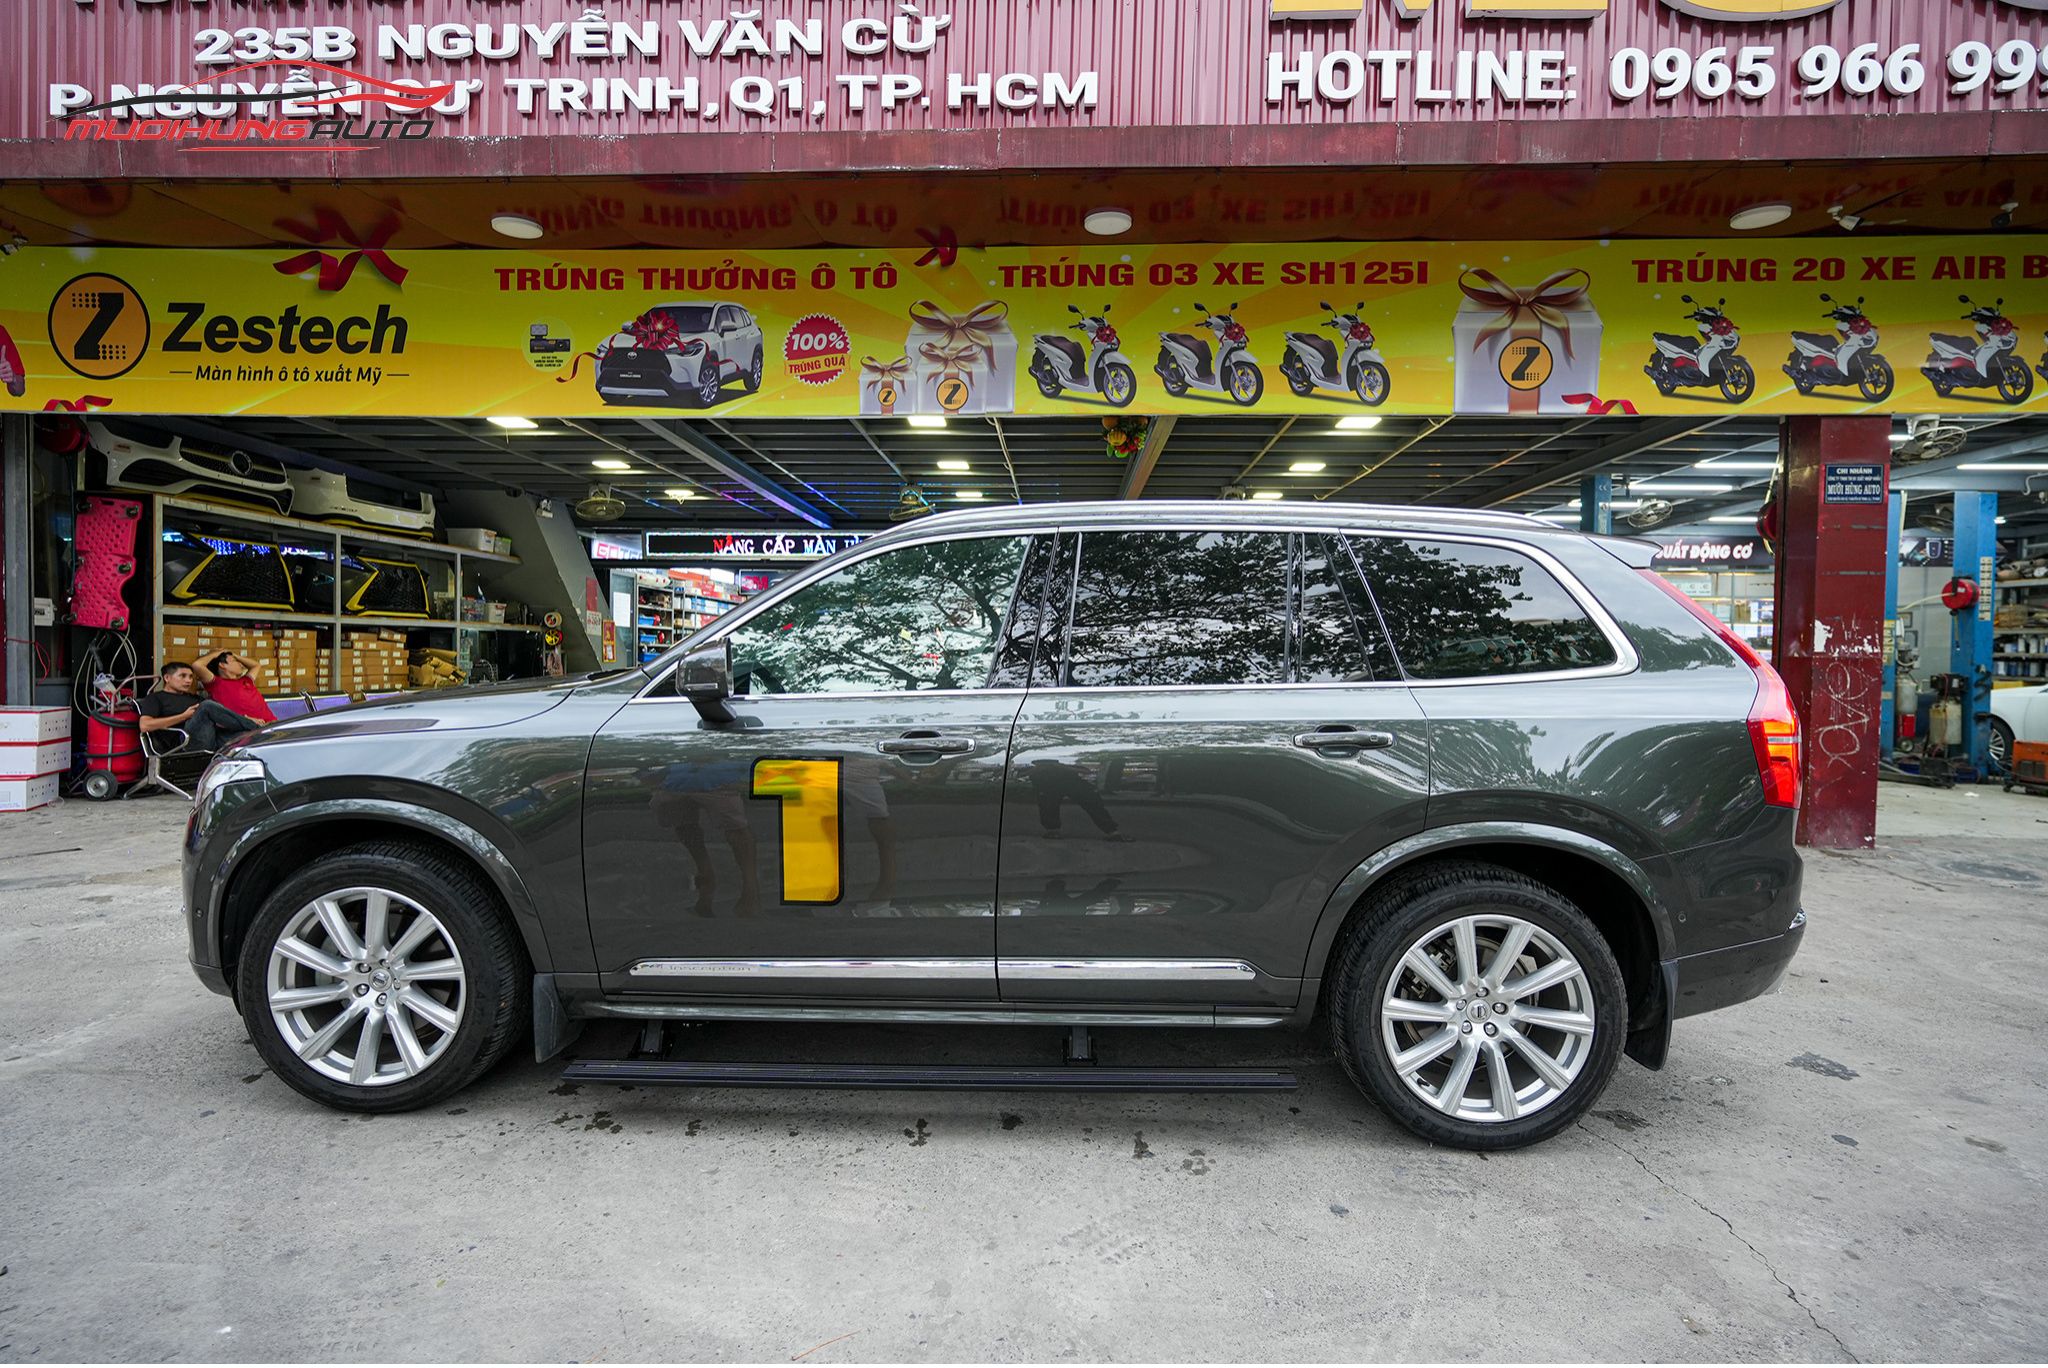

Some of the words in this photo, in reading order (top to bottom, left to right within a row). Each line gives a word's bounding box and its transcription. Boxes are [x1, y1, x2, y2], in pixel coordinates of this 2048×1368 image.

[195, 26, 356, 63] 235B
[378, 8, 659, 60] NGUYỄN
[678, 9, 823, 56] VĂN
[840, 4, 951, 54] CỪ
[1268, 49, 1576, 102] HOTLINE:
[1609, 46, 1776, 100] 0965
[1800, 43, 1926, 97] 966
[1947, 40, 2048, 94] 99
[947, 71, 1098, 109] HCM
[495, 262, 624, 291] TRÚNG
[638, 259, 796, 290] THƯỞNG
[811, 262, 836, 290] Ô
[850, 262, 898, 289] TÔ
[998, 257, 1134, 288] TRÚNG
[1149, 264, 1198, 287] 03
[1213, 262, 1264, 286] XE
[1280, 261, 1429, 286] SH125I
[1631, 252, 1777, 283] TRÚNG
[1792, 257, 1846, 282] 20
[1861, 256, 1916, 281] XE
[1931, 256, 2006, 280] AIR
[162, 303, 408, 354] Zestech
[792, 332, 844, 351] 100%
[195, 365, 232, 382] Màn
[237, 365, 274, 382] hình
[278, 366, 288, 382] ô
[293, 366, 309, 382] tô
[314, 363, 353, 382] xuất
[357, 366, 382, 386] Mỹ
[788, 360, 821, 374] TRÚNG
[1863, 484, 1881, 495] AUTO
[713, 534, 755, 554] NÂNG
[763, 534, 795, 554] CẤP
[803, 534, 836, 554] MÀN
[1689, 541, 1732, 563] ĐỘNG
[1733, 541, 1754, 559] CƠ
